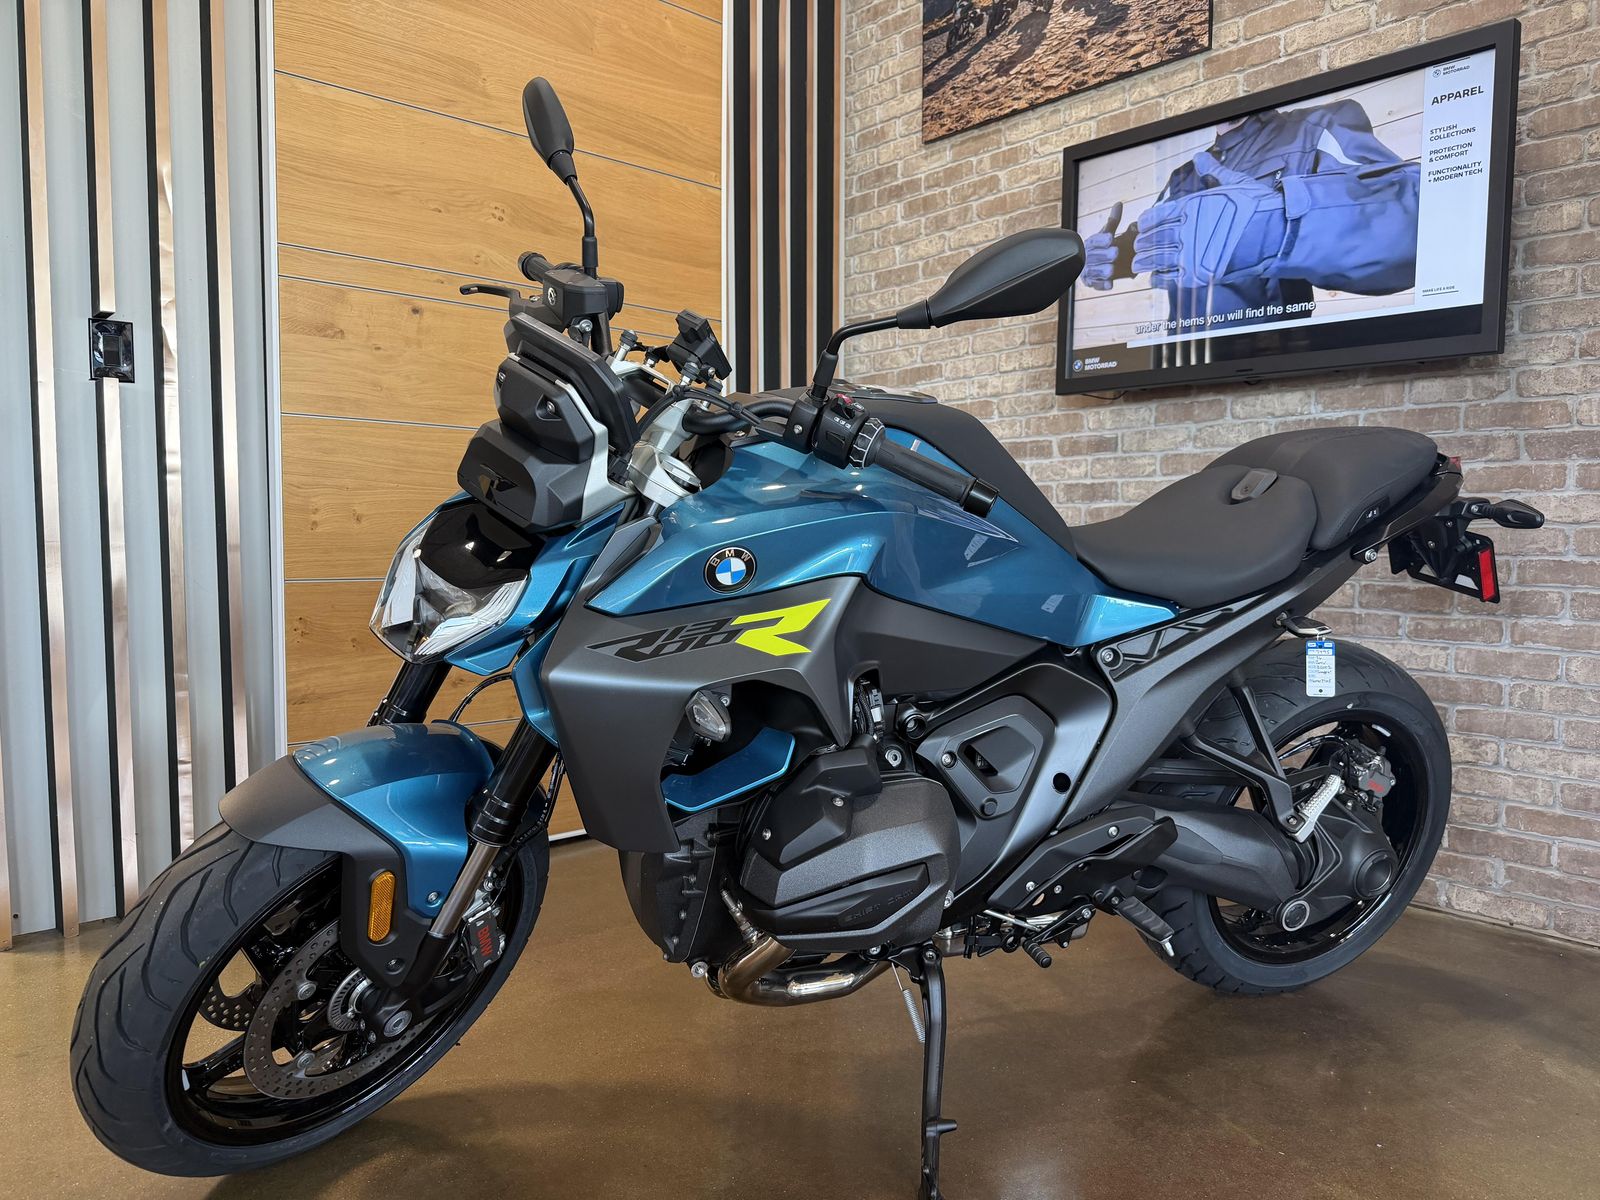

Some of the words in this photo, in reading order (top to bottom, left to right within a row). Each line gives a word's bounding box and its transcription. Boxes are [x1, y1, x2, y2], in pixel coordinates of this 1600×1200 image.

[1431, 85, 1484, 105] APPAREL
[1430, 124, 1458, 135] STYLISH
[1430, 126, 1476, 142] COLLECTIONS
[1429, 142, 1473, 156] PROTECTION
[1434, 150, 1469, 162] COMFORT
[1428, 160, 1482, 177] FUNCTIONALITY
[1433, 172, 1464, 183] MODERN
[1464, 168, 1483, 177] TECH
[1135, 322, 1162, 334] under
[1162, 318, 1177, 330] the
[1178, 315, 1204, 328] hems
[1206, 313, 1225, 326] you
[1227, 309, 1243, 321] will
[1245, 307, 1264, 319] find
[1266, 304, 1283, 315] the
[1285, 301, 1316, 314] same
[1084, 357, 1100, 365] BMW
[1084, 361, 1118, 371] MOTORRAD
[710, 549, 750, 568] BMW
[477, 926, 493, 957] BMW
